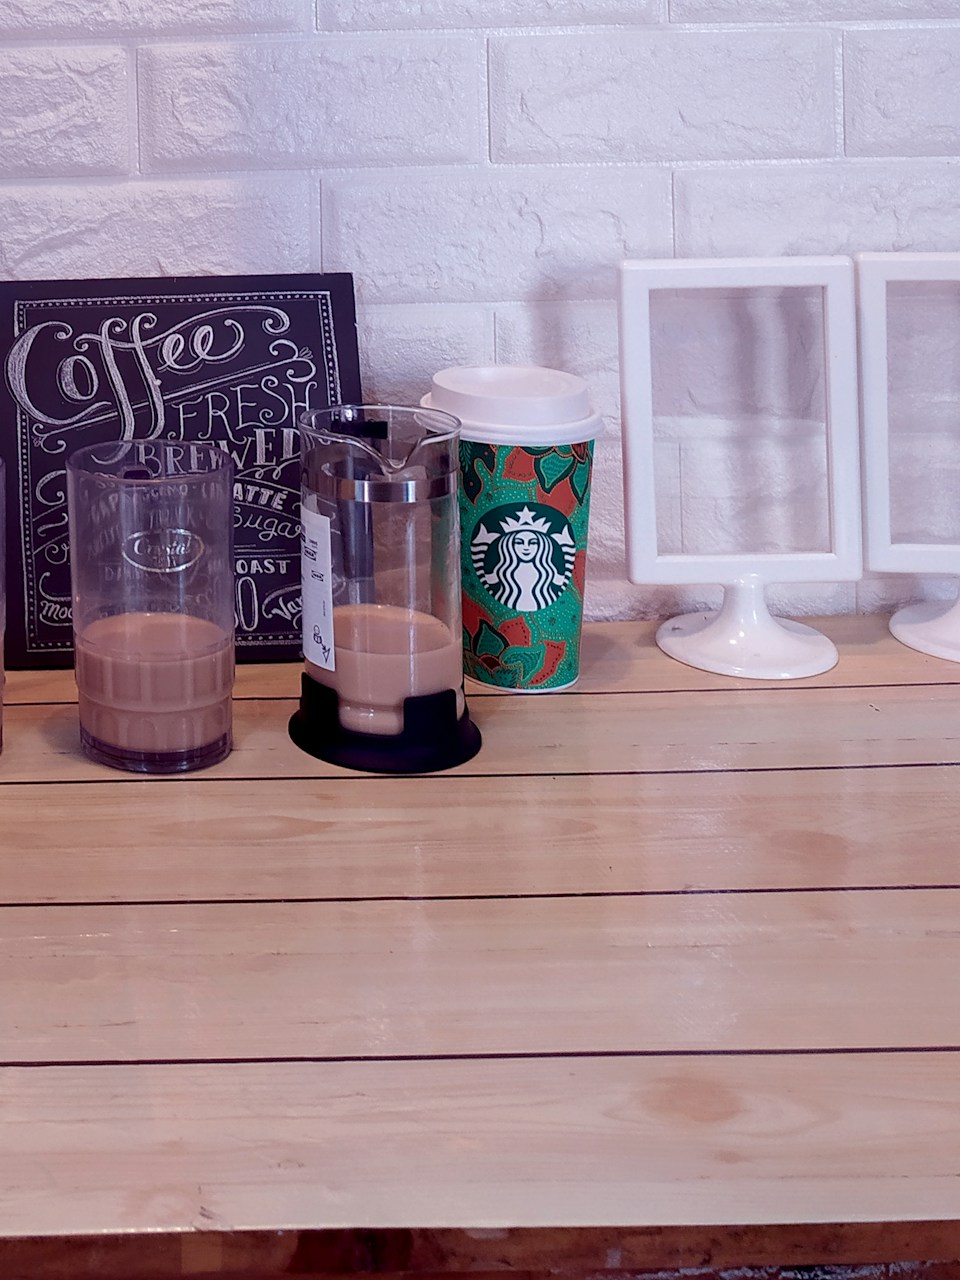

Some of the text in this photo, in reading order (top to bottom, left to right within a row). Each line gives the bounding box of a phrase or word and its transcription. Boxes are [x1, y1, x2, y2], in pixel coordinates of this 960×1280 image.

[5, 307, 289, 464] Coffee
[167, 376, 317, 442] FRESH
[235, 558, 290, 575] OAST
